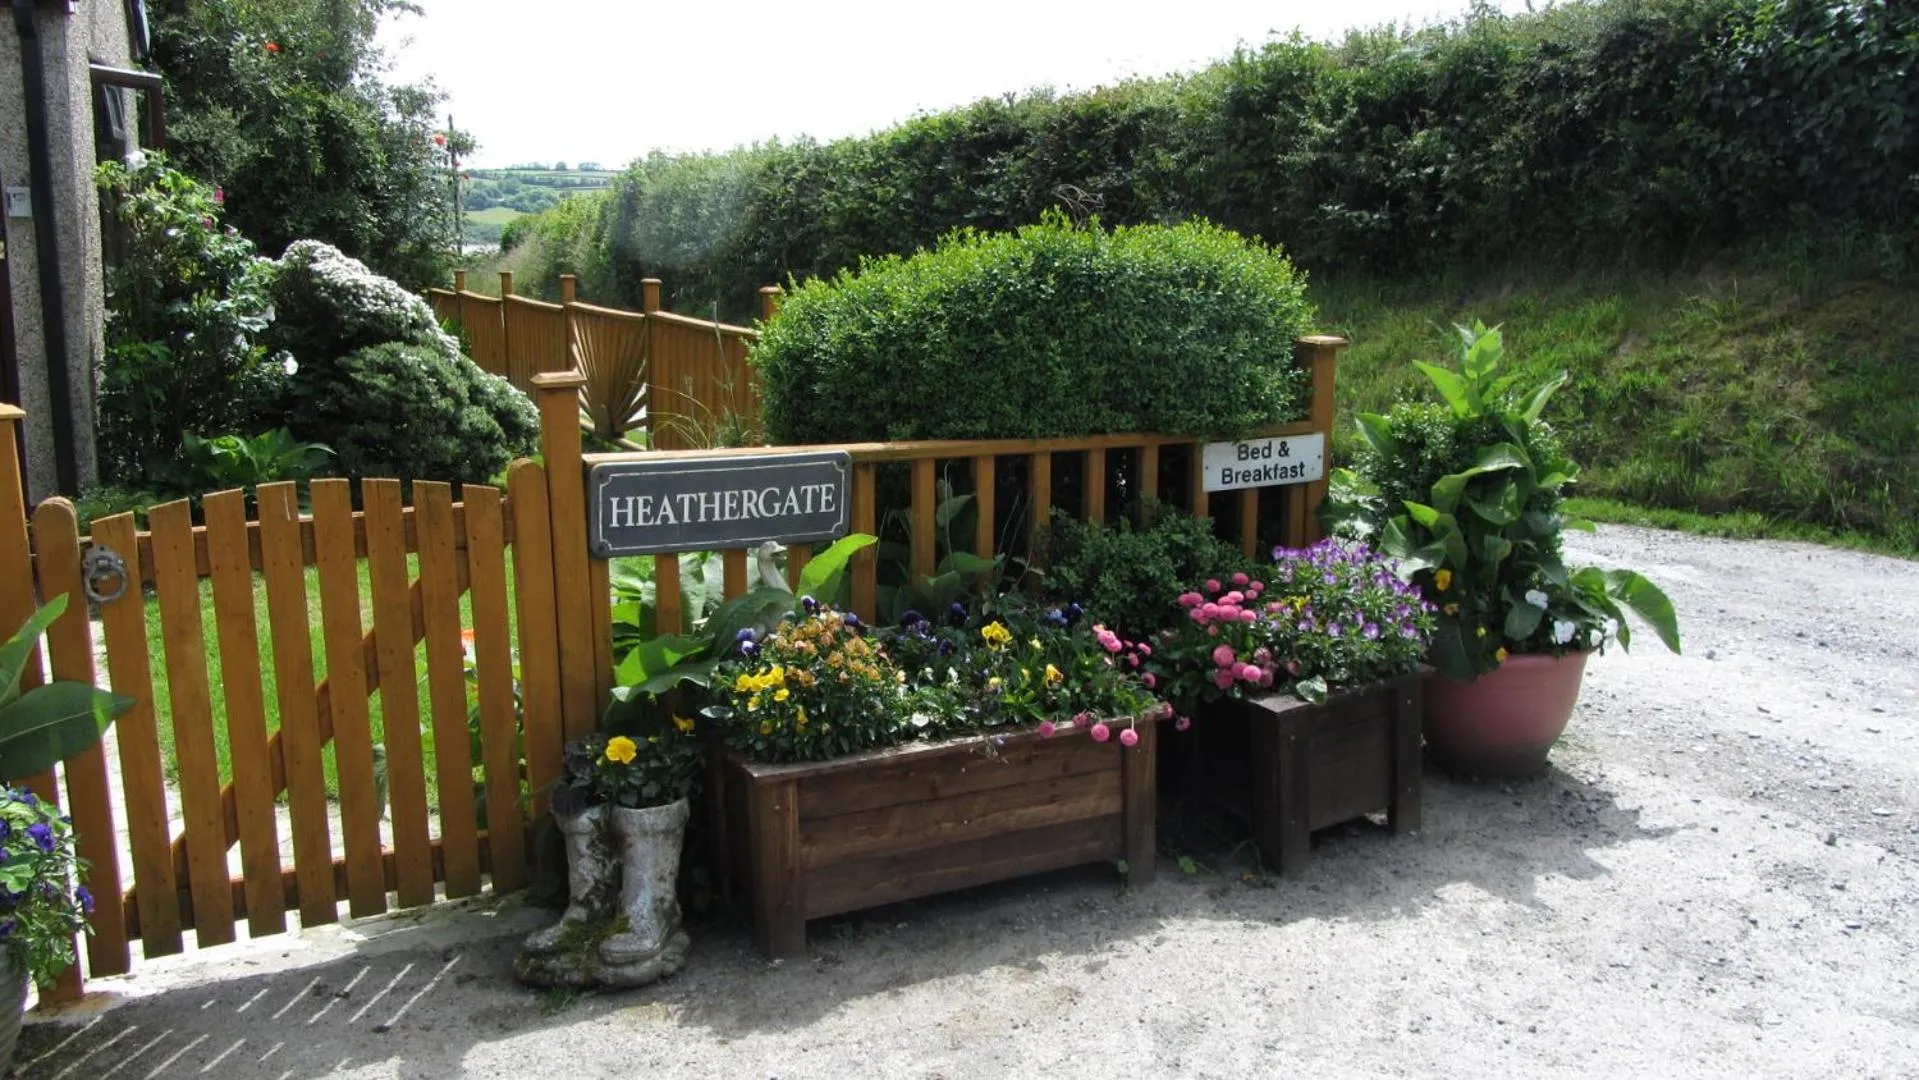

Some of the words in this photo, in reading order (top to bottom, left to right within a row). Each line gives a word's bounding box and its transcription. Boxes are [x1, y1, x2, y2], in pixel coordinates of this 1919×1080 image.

[1237, 441, 1272, 461] Bed
[1278, 441, 1290, 458] &
[1221, 461, 1305, 485] Breakfast
[609, 483, 836, 528] HEATHERGATE
